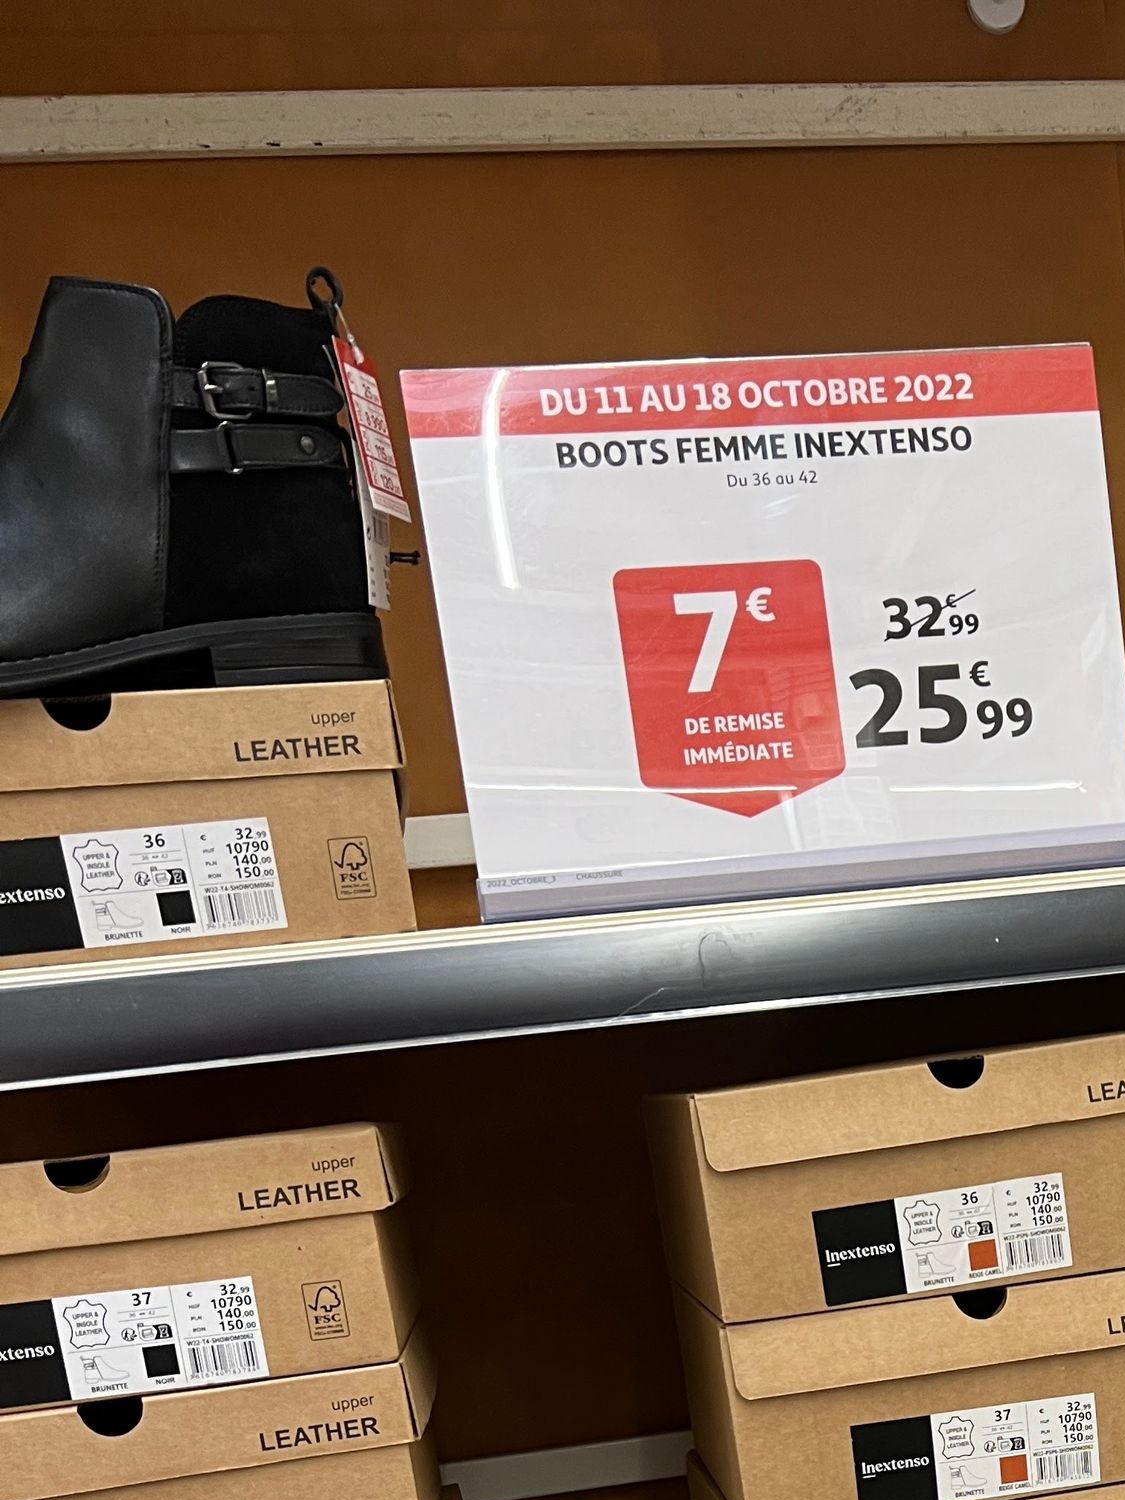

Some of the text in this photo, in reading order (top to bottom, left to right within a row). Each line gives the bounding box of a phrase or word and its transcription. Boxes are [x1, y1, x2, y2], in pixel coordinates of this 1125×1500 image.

[539, 373, 973, 416] DU 11 AU 18 OCTOBRE 2022
[556, 426, 971, 467] BOOTS FEMME INEXTENSO
[727, 471, 817, 487] Du 36 au 42
[311, 712, 355, 727] upper
[685, 712, 785, 734] DE REMISE
[234, 735, 361, 761] LEATHER
[684, 741, 793, 765] IMMÉDIATE
[144, 834, 165, 848] 36
[225, 840, 268, 855] 10790
[340, 871, 367, 882] FSC
[0, 888, 65, 904] extenso
[104, 930, 143, 940] BRUNETTE
[312, 1157, 354, 1173] upper
[238, 1179, 360, 1210] LEATHER
[962, 1192, 978, 1205] 36
[1025, 1192, 1060, 1206] 10790
[826, 1244, 895, 1262] Inextenso
[924, 1277, 954, 1286] BRUNETTE
[132, 1292, 150, 1306] 37
[210, 1295, 252, 1309] 10790
[314, 1314, 341, 1324] FSC
[995, 1409, 1010, 1421] 37
[260, 1417, 382, 1454] LEATHER
[862, 1457, 929, 1474] Inextenso
